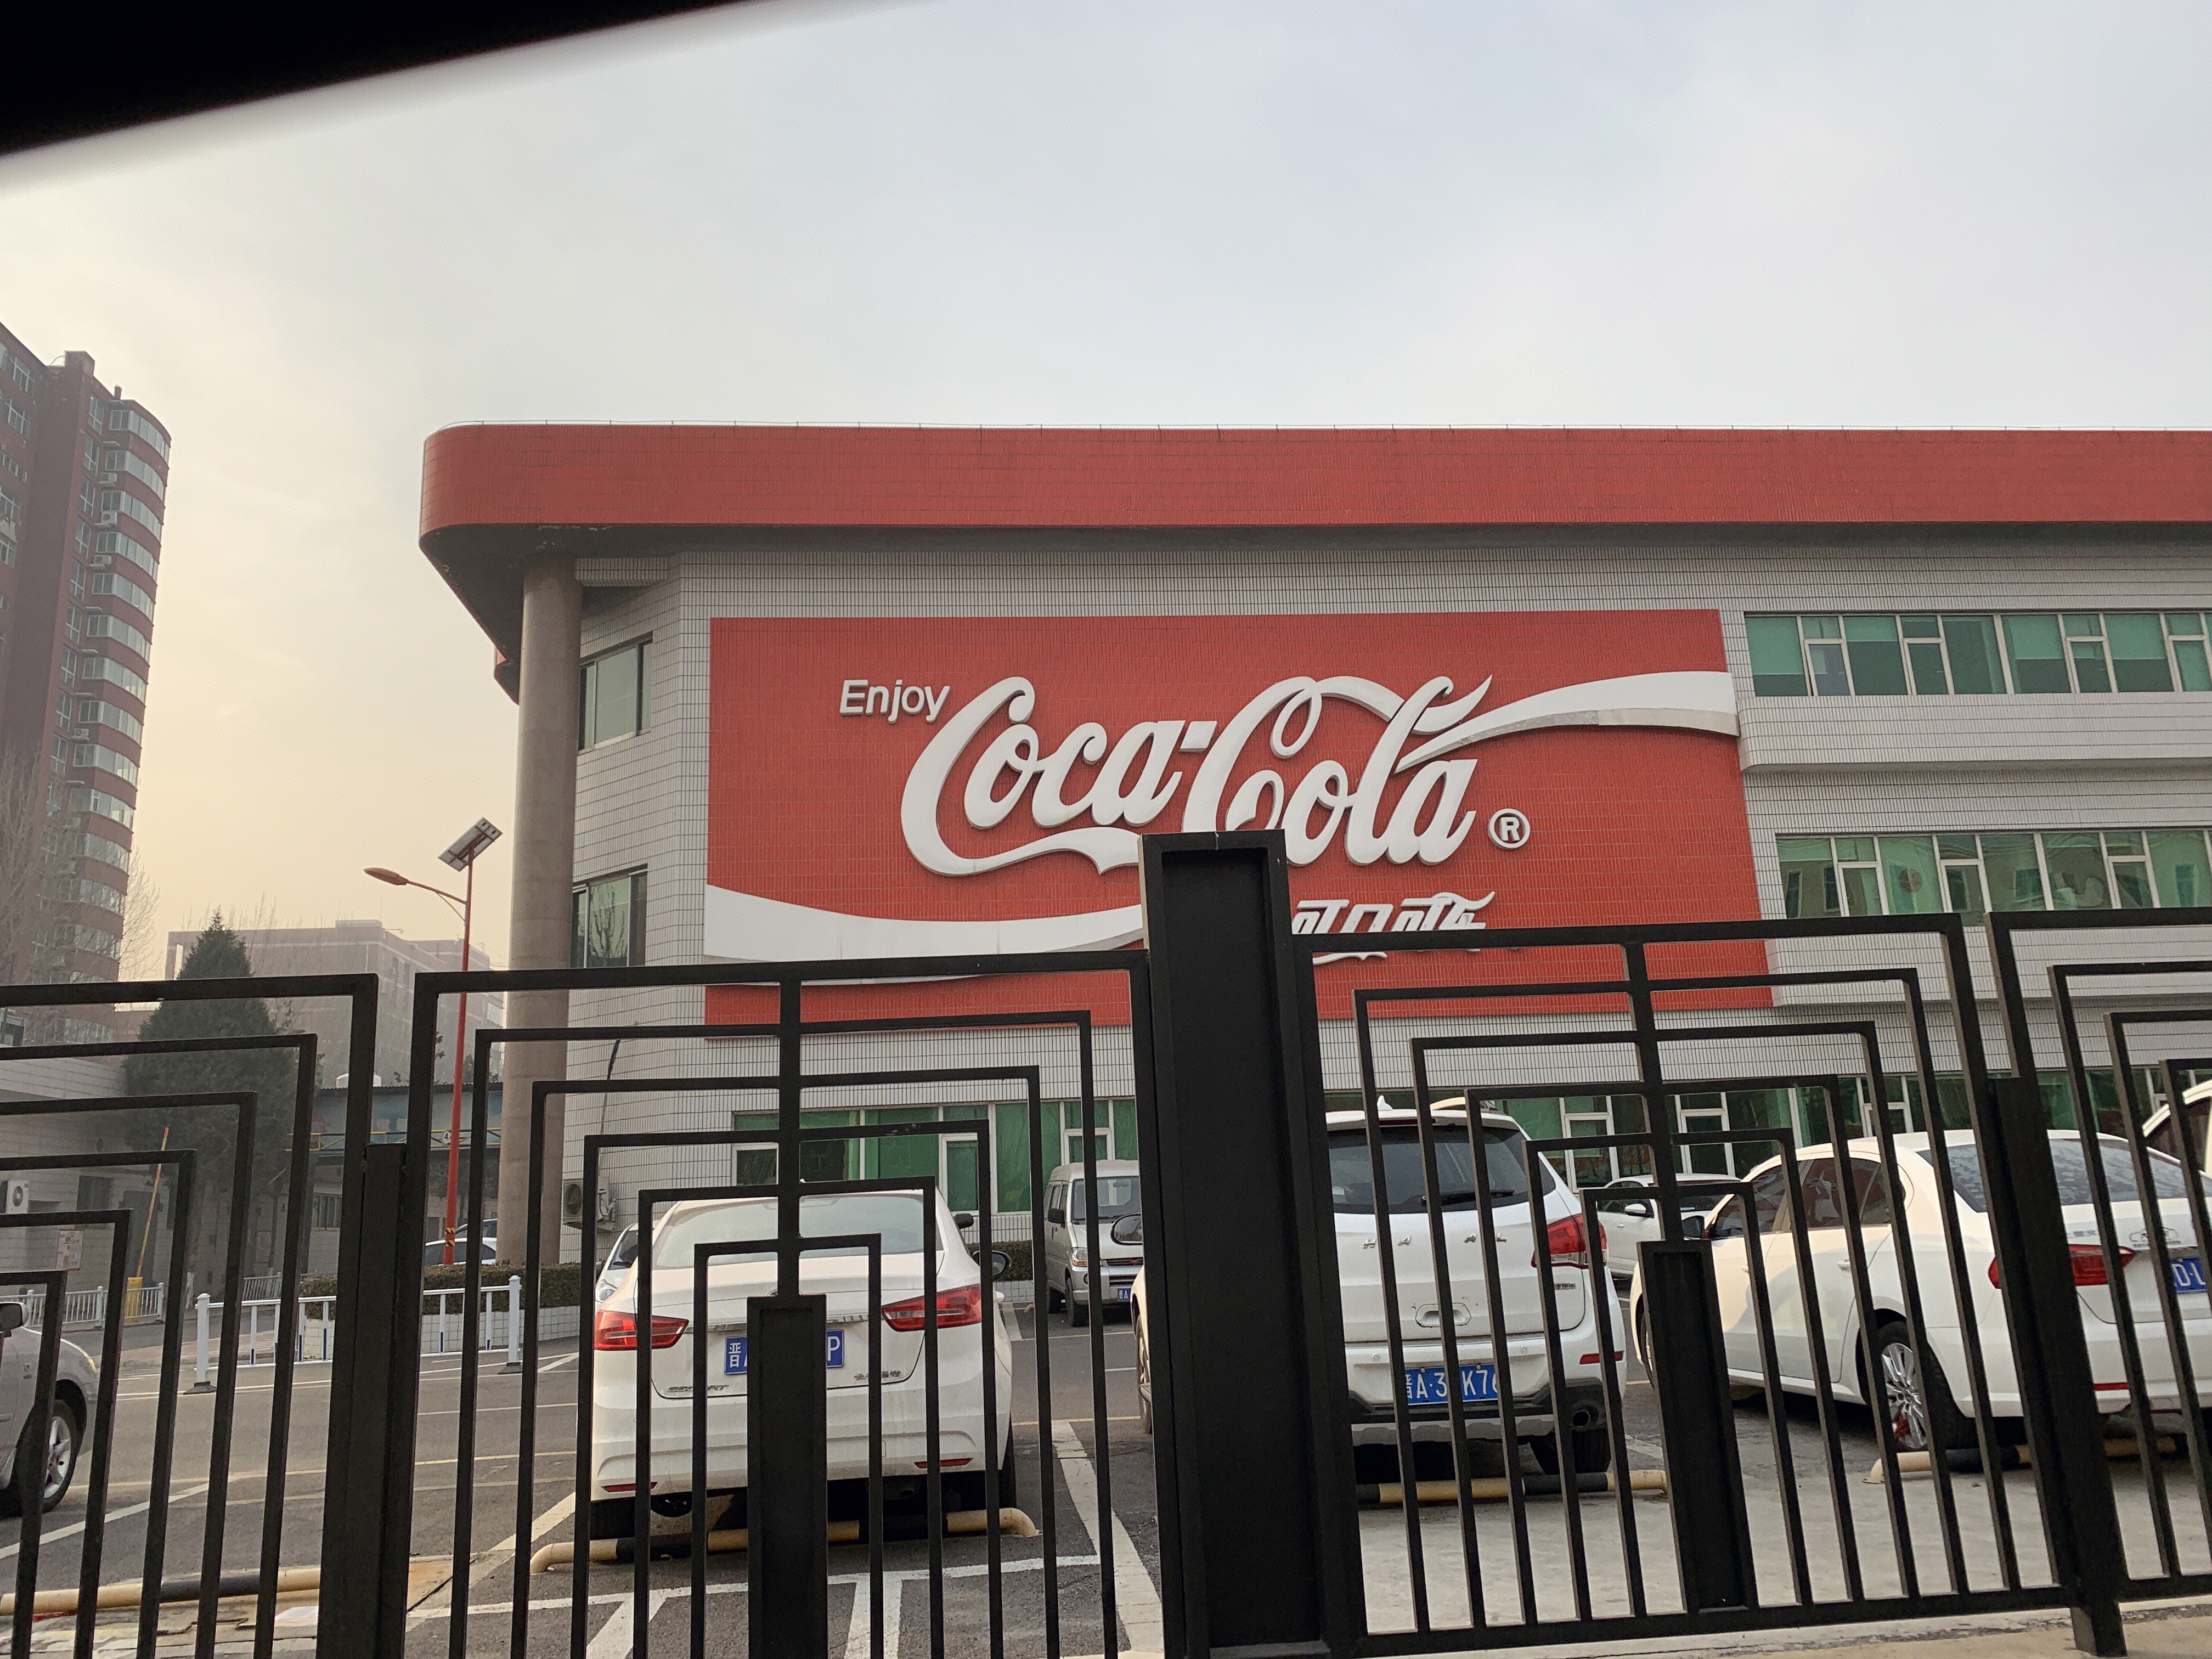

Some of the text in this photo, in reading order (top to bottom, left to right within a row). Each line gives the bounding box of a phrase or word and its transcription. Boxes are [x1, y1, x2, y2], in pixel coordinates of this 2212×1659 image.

[839, 679, 950, 724] Enjoy
[901, 675, 1492, 877] Coca-Cola
[1363, 1233, 1506, 1249] HAAL
